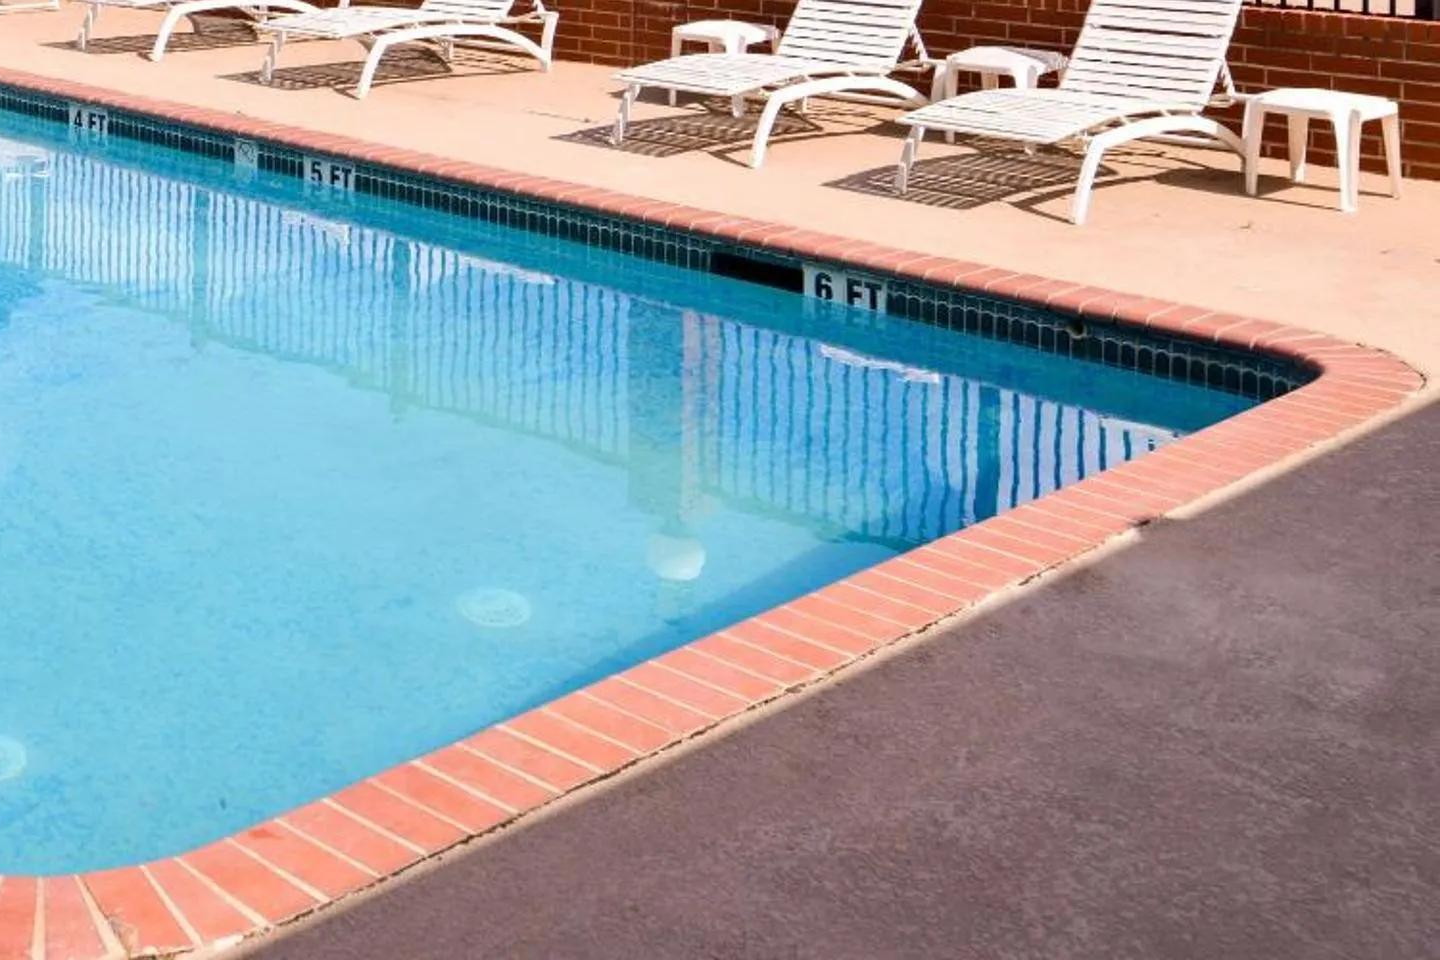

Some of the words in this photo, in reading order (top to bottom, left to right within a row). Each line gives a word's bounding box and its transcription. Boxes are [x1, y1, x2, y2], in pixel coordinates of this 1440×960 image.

[73, 110, 83, 128] 4
[88, 111, 106, 132] FT
[311, 160, 323, 181] 5
[330, 164, 352, 188] FT
[814, 271, 833, 300] 6
[846, 277, 882, 310] FT
